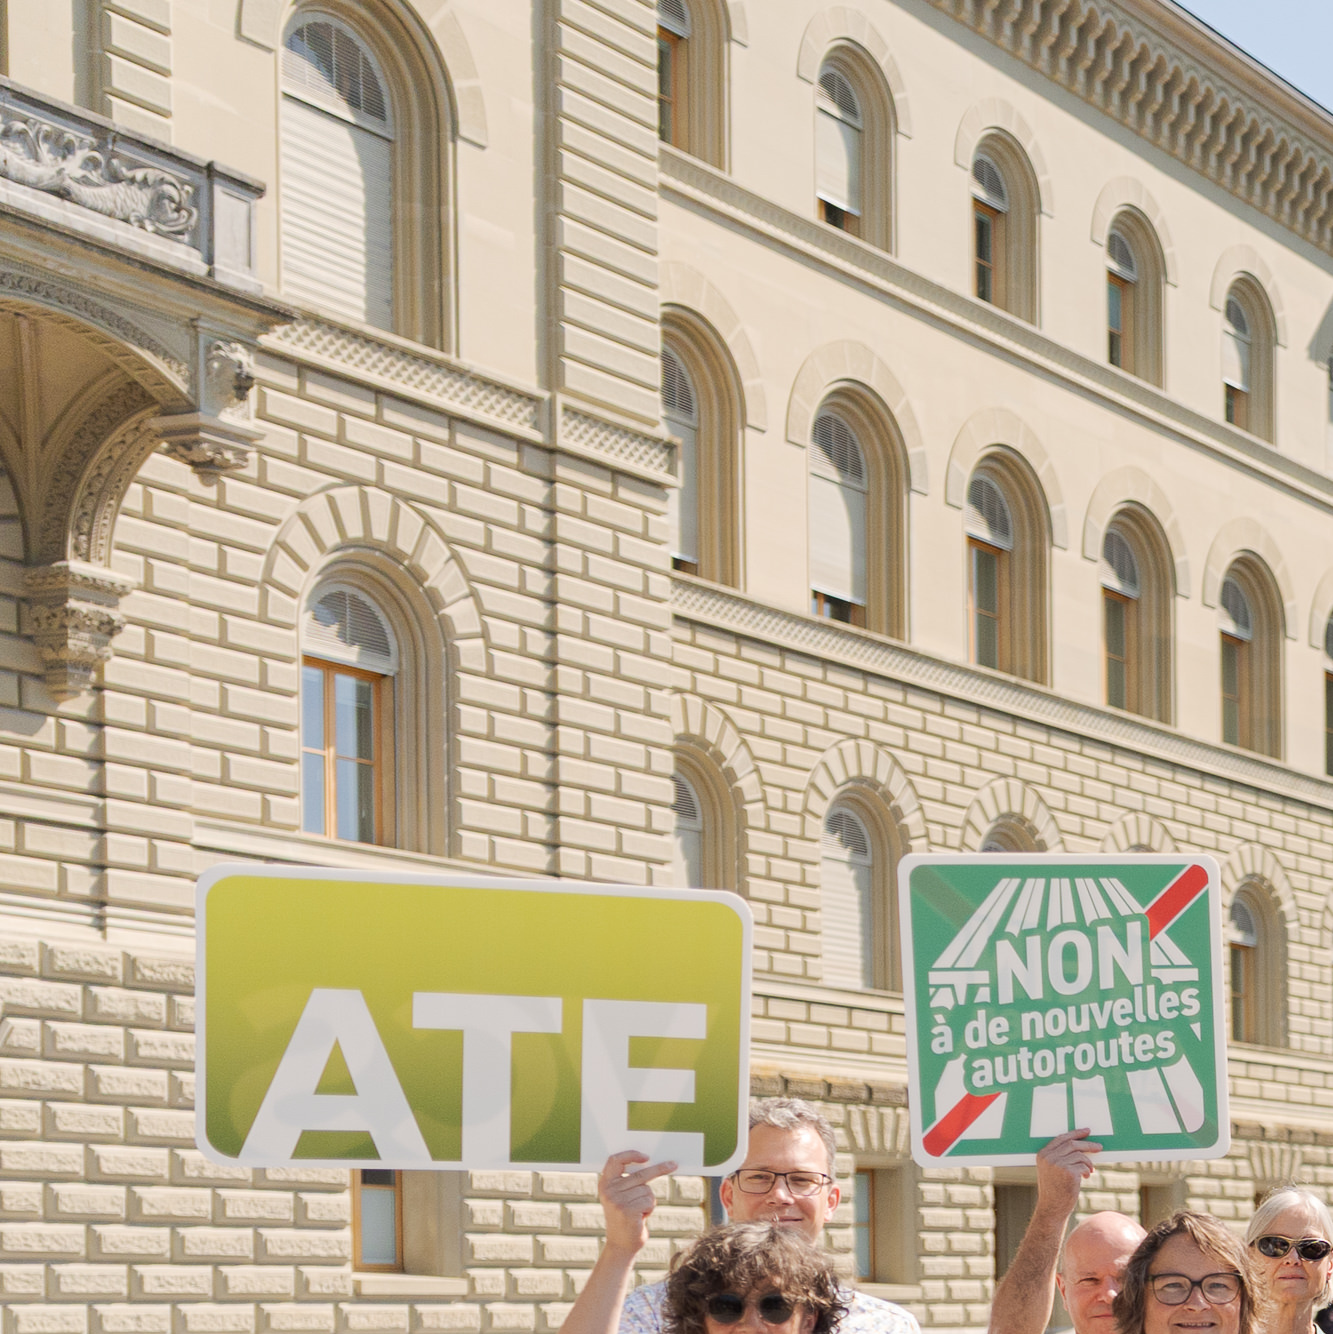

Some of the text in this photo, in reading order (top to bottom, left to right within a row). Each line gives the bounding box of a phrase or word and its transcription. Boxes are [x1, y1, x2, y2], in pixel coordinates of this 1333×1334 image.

[996, 921, 1144, 1004] NON
[930, 984, 1201, 1054] à de nouvelles
[238, 988, 707, 1167] ATE
[971, 1030, 1176, 1088] autoroutes
